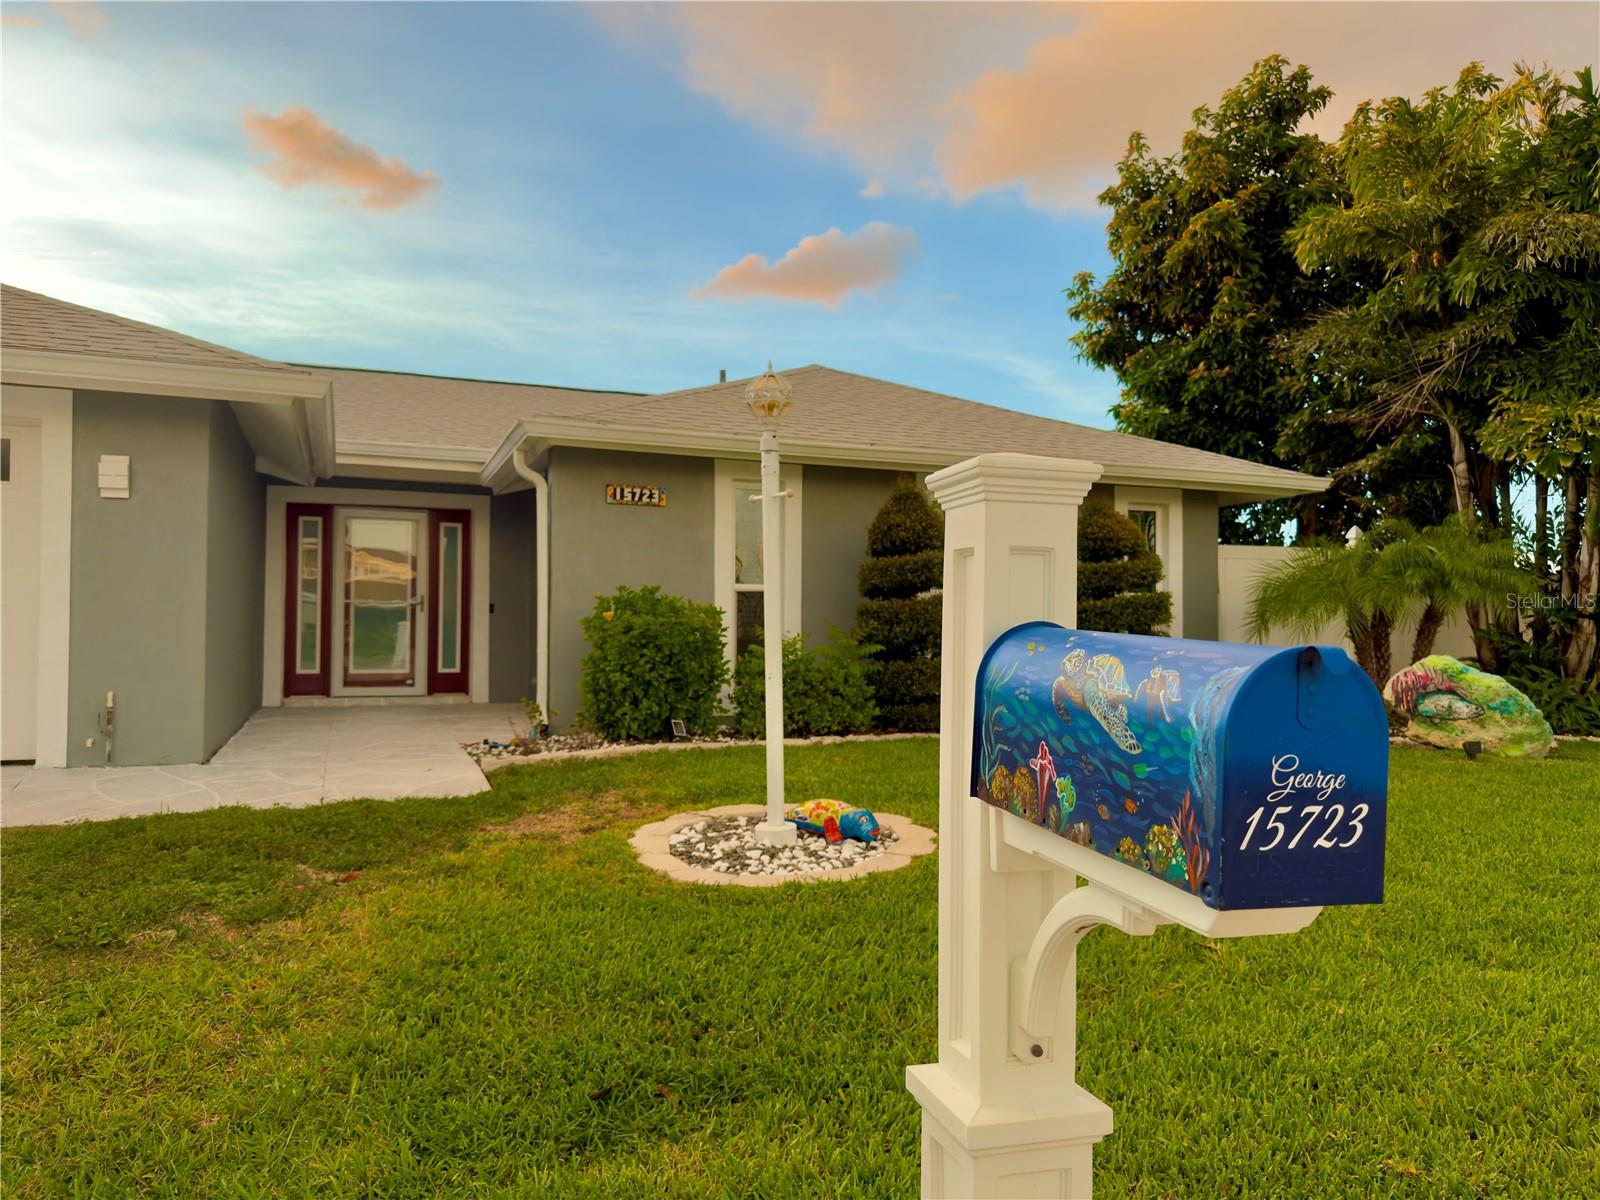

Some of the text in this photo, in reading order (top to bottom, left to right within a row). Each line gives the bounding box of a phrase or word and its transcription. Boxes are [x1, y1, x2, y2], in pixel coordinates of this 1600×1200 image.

[615, 485, 659, 503] 15723
[1266, 754, 1346, 802] George
[1239, 803, 1369, 851] 15723
